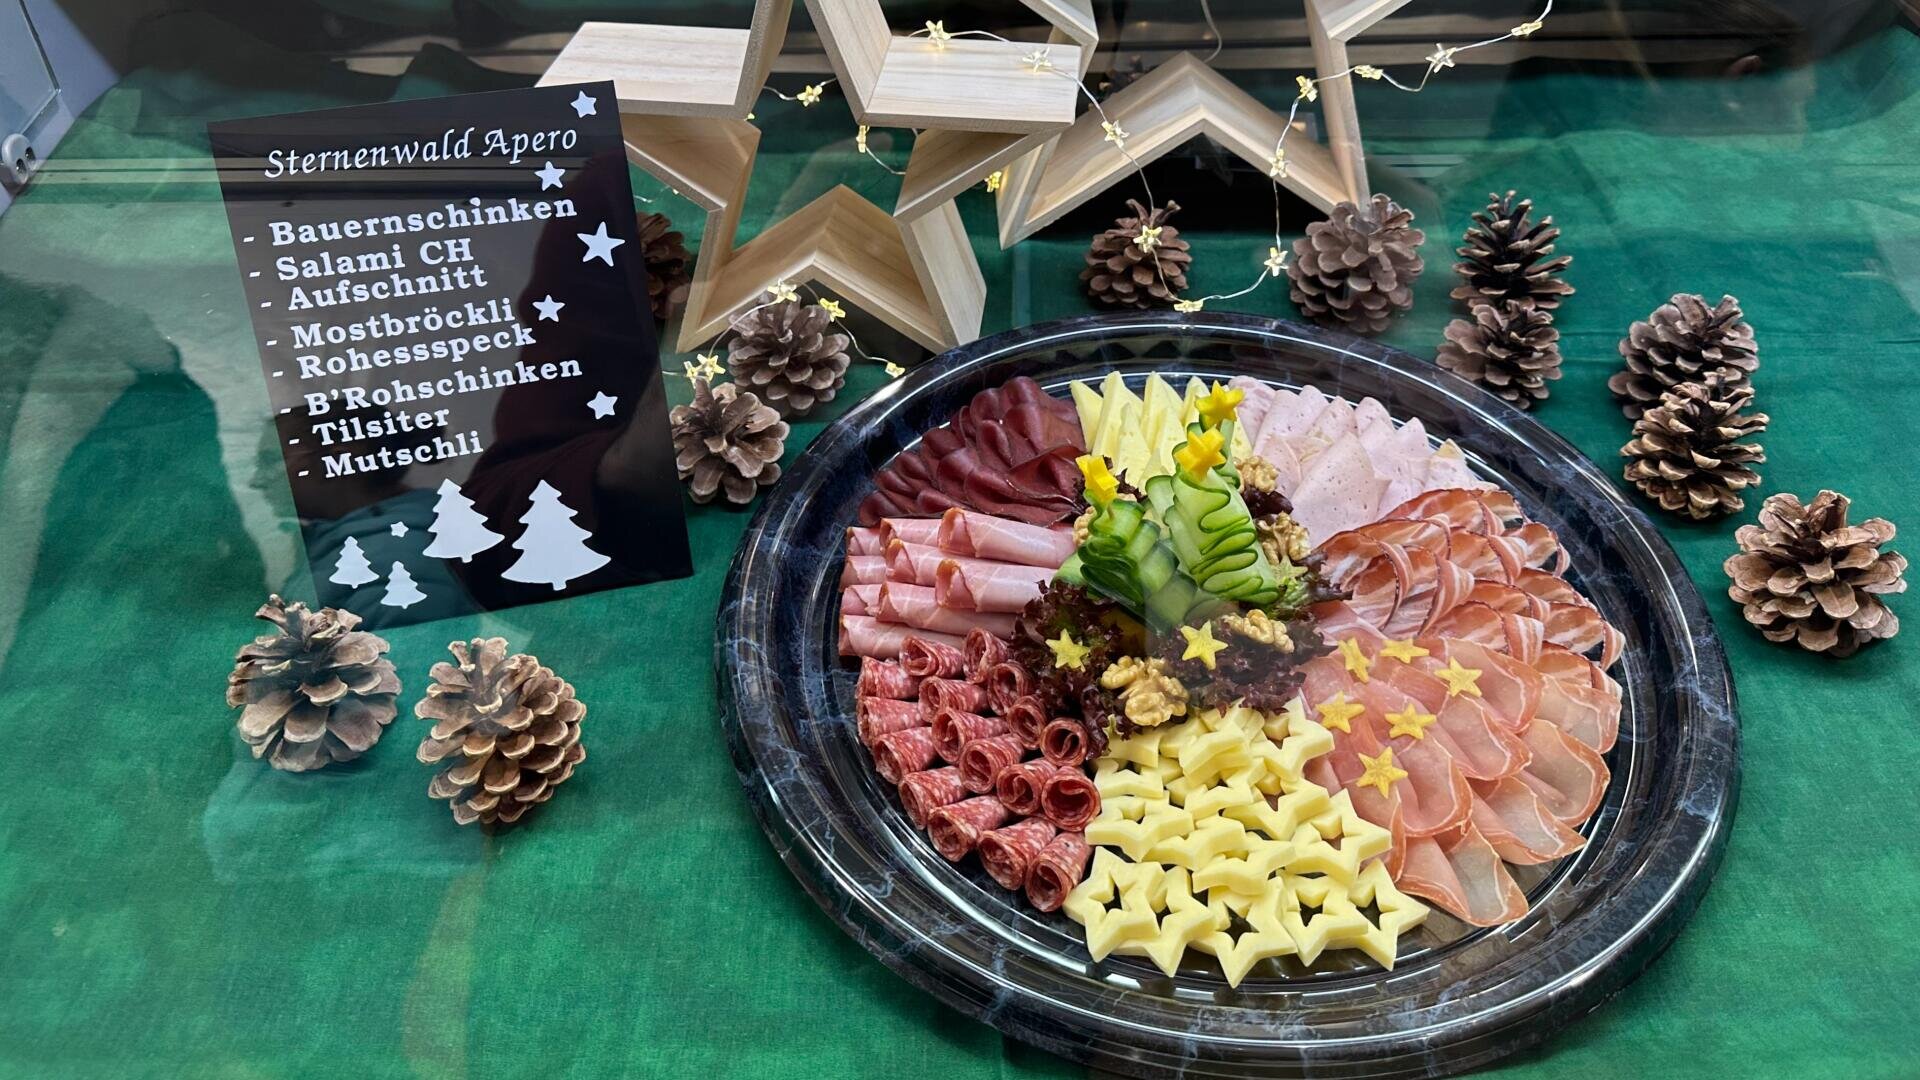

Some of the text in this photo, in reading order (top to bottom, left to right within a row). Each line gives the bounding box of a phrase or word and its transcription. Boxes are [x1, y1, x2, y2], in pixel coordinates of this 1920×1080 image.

[264, 126, 577, 179] Sternenwald Apero
[268, 197, 578, 246] Bauernschinken
[275, 243, 406, 281] Salami
[419, 237, 474, 265] CH
[287, 264, 488, 311] Aufschnitt
[289, 297, 516, 349] Mostbröckli
[295, 322, 537, 380] Rohessspeck
[303, 359, 583, 416] B'Rohschinken
[312, 408, 450, 446] Tilsiter
[321, 430, 484, 478] Mutschli
